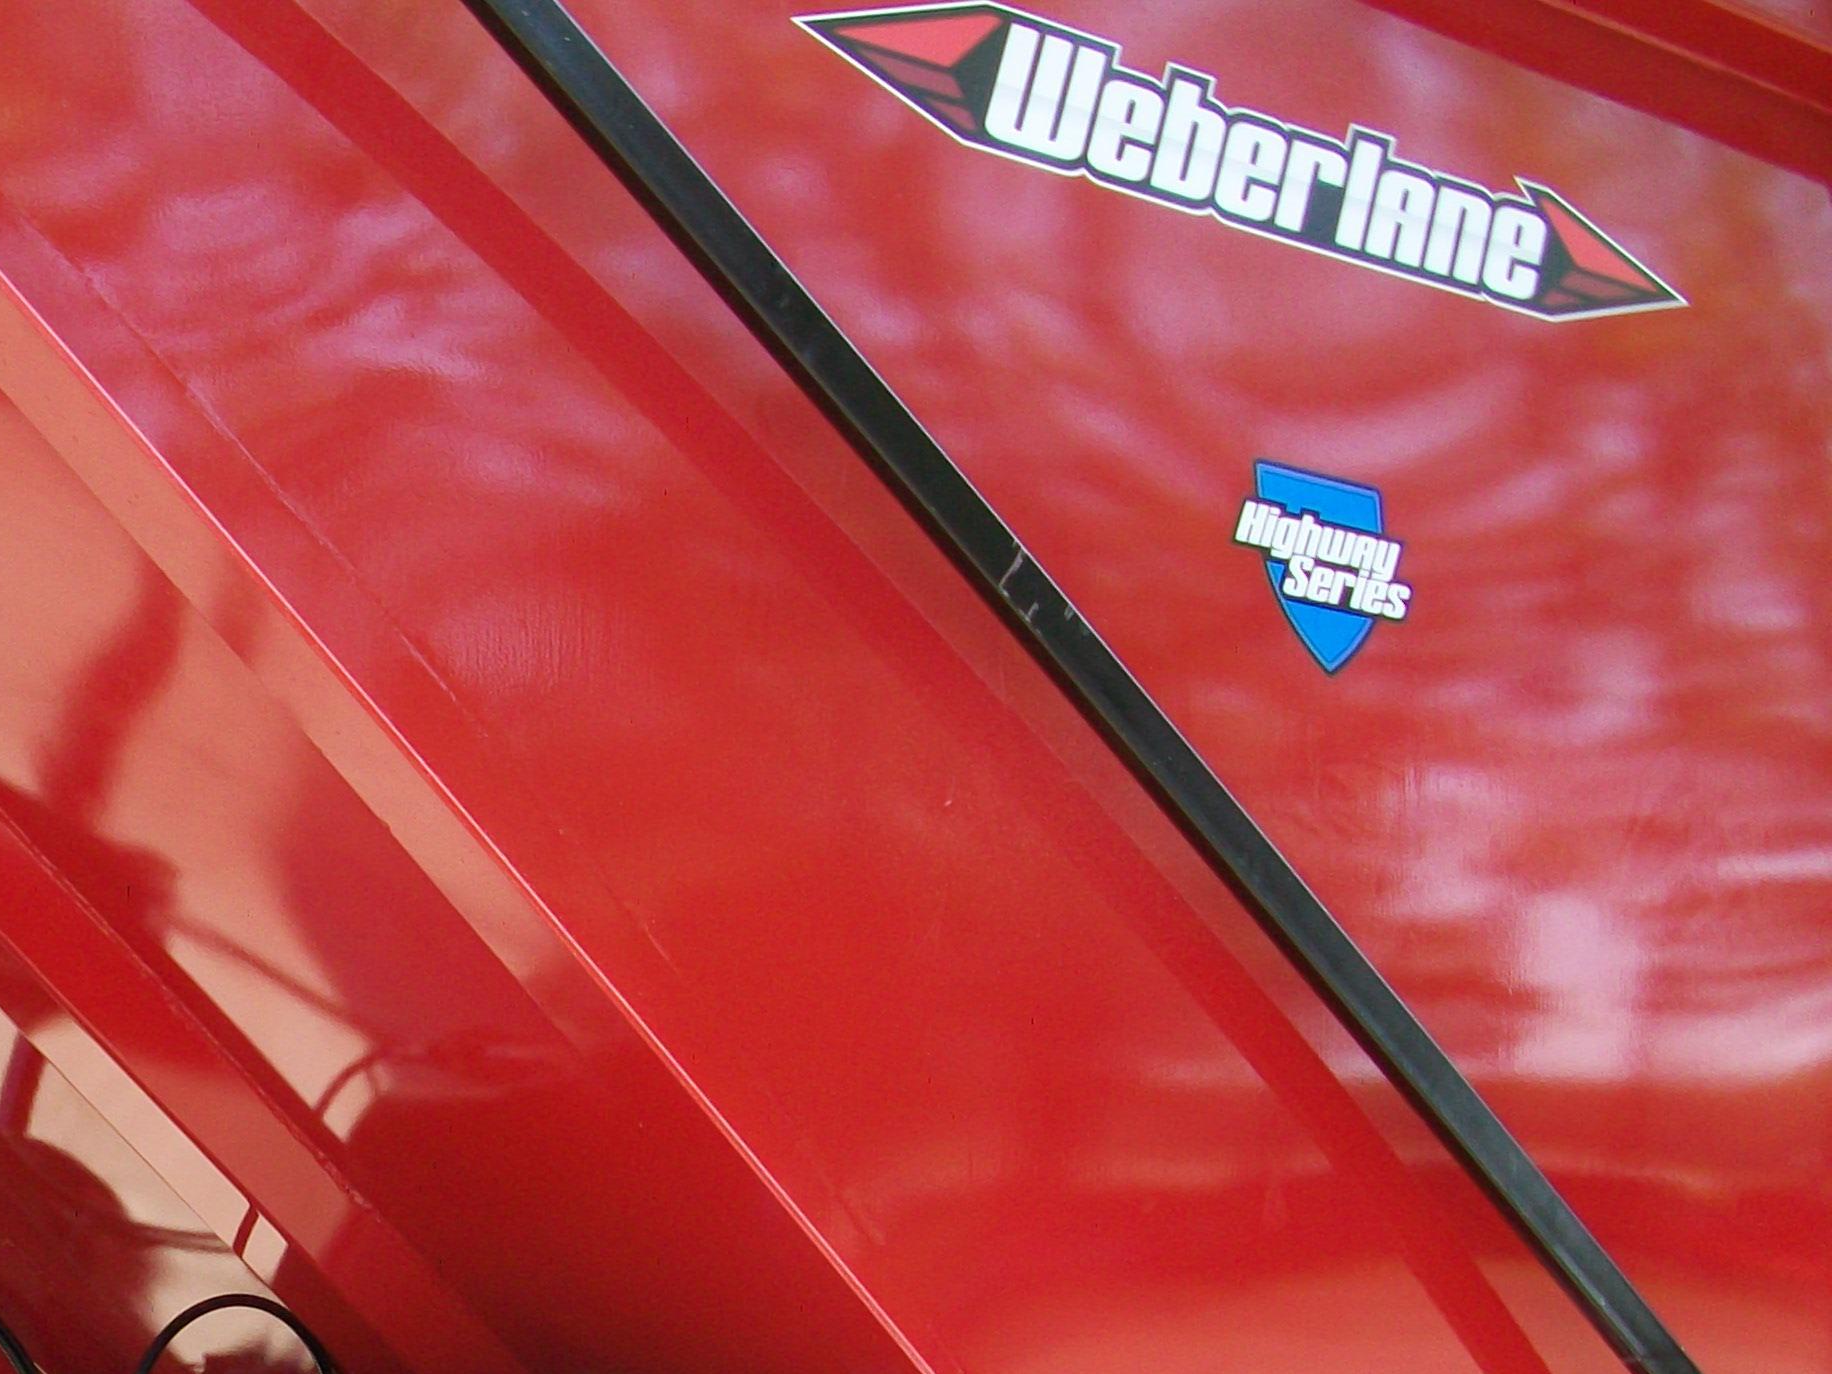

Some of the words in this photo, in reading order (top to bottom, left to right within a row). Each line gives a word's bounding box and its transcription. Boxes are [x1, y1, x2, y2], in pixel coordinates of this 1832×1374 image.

[984, 23, 1548, 301] Weberlane
[1235, 500, 1402, 583] Highway
[1283, 556, 1411, 621] Series
